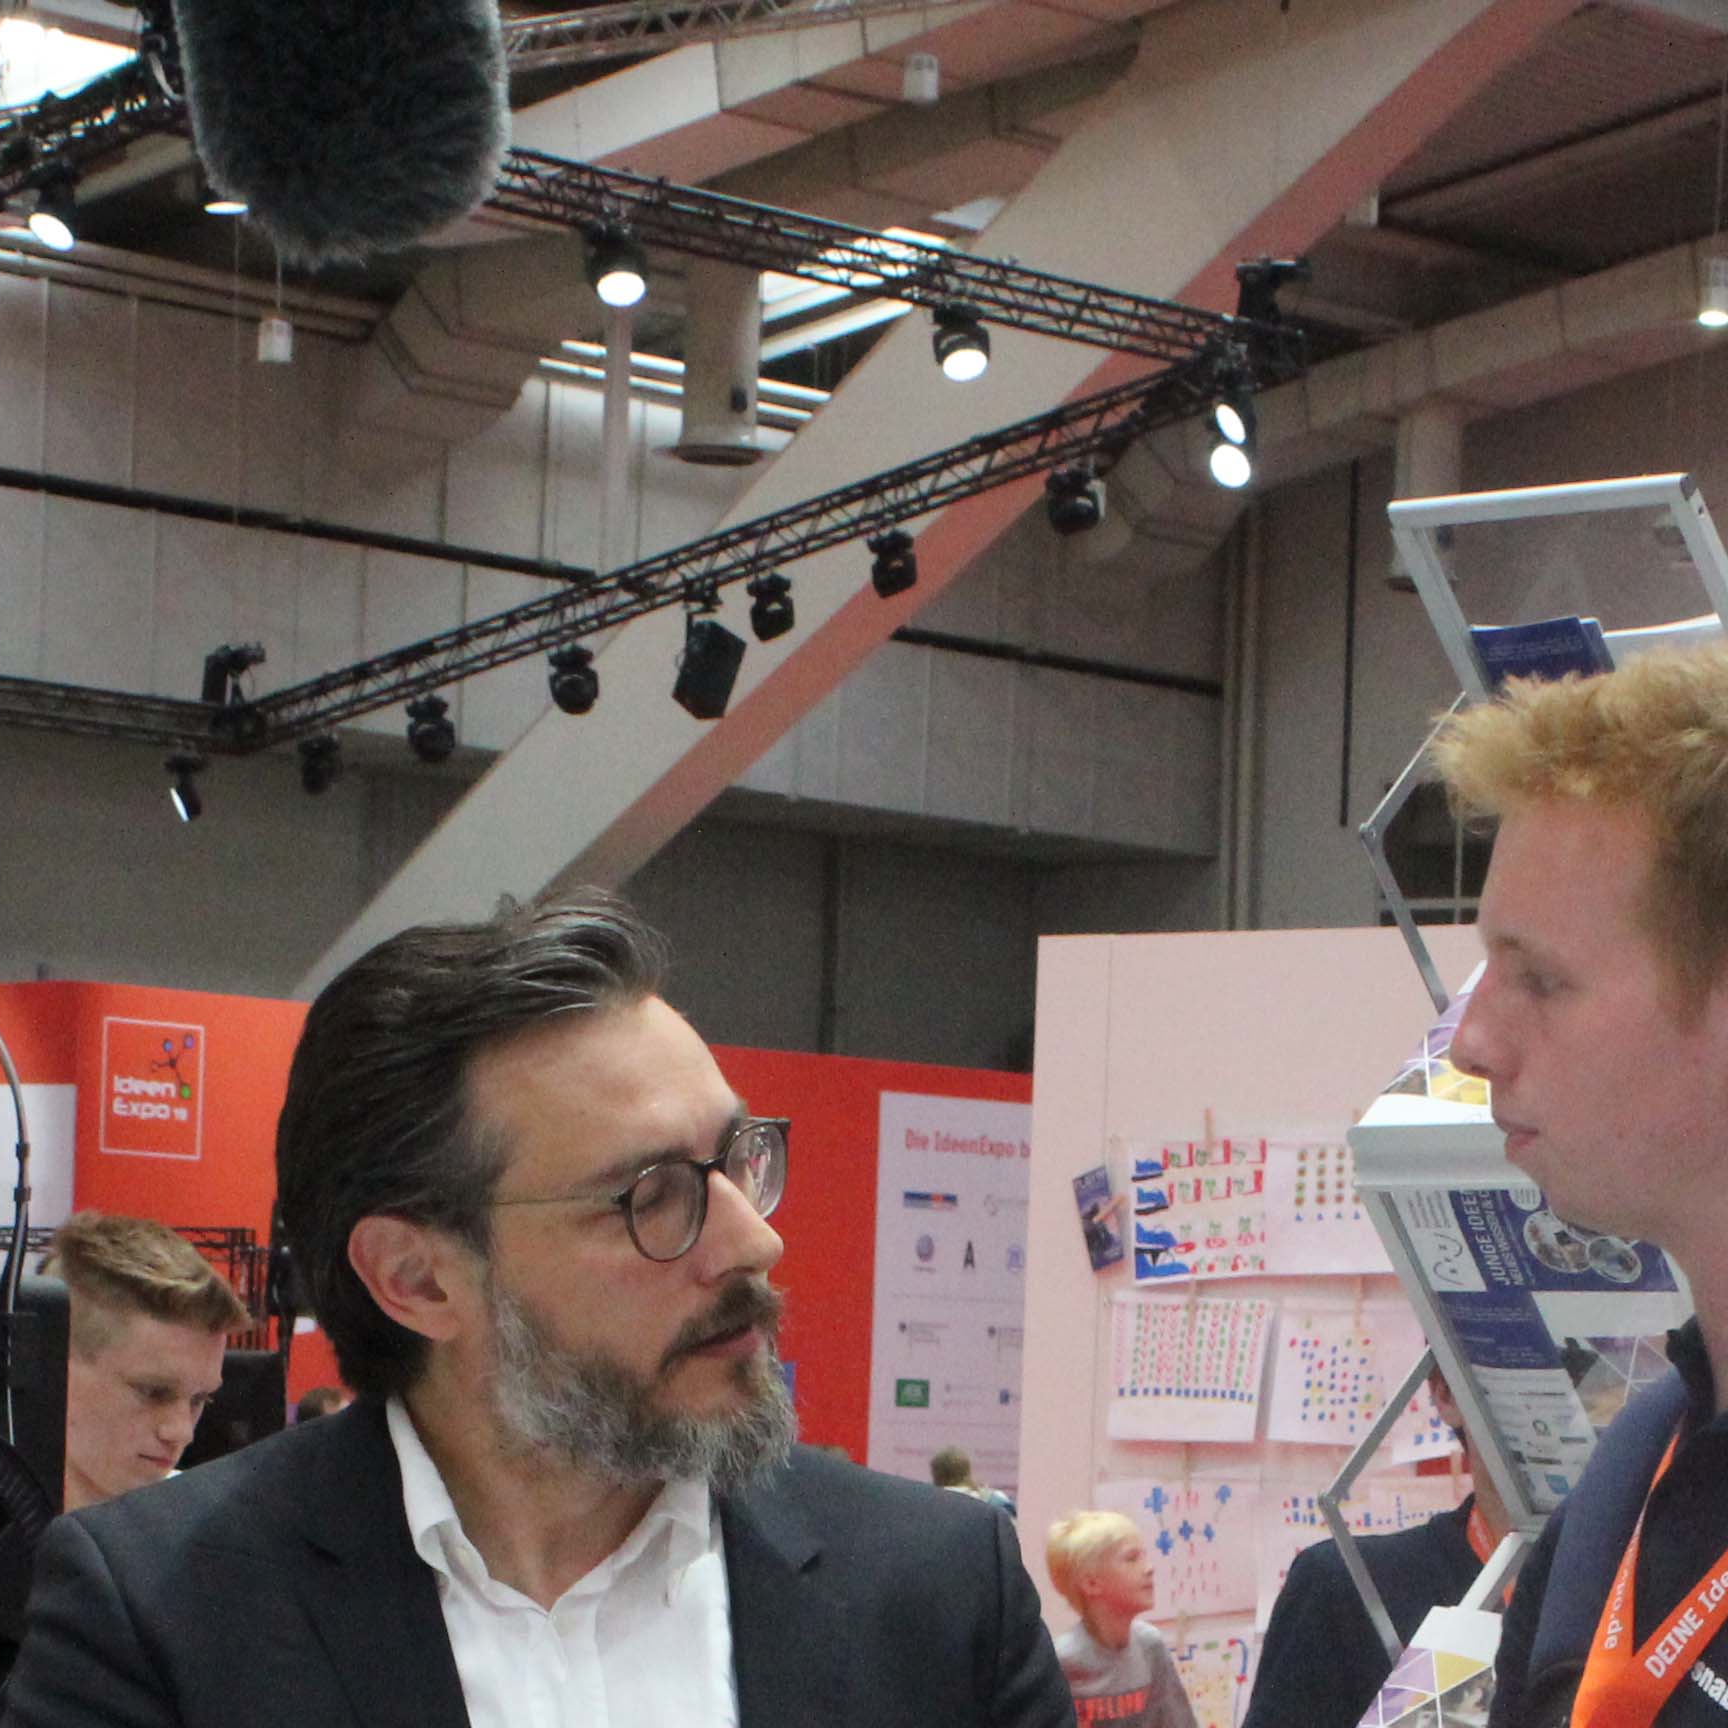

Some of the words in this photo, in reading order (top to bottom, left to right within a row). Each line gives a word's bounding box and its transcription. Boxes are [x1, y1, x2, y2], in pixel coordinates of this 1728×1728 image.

[113, 1075, 179, 1099] Ideen
[113, 1098, 170, 1122] Expo
[904, 1128, 930, 1151] Die
[933, 1130, 1016, 1159] IdeenExpo
[1020, 1140, 1031, 1158] b
[1460, 1189, 1487, 1232] IDEE
[1475, 1234, 1511, 1286] JUNGE
[1644, 1607, 1706, 1679] DEINE
